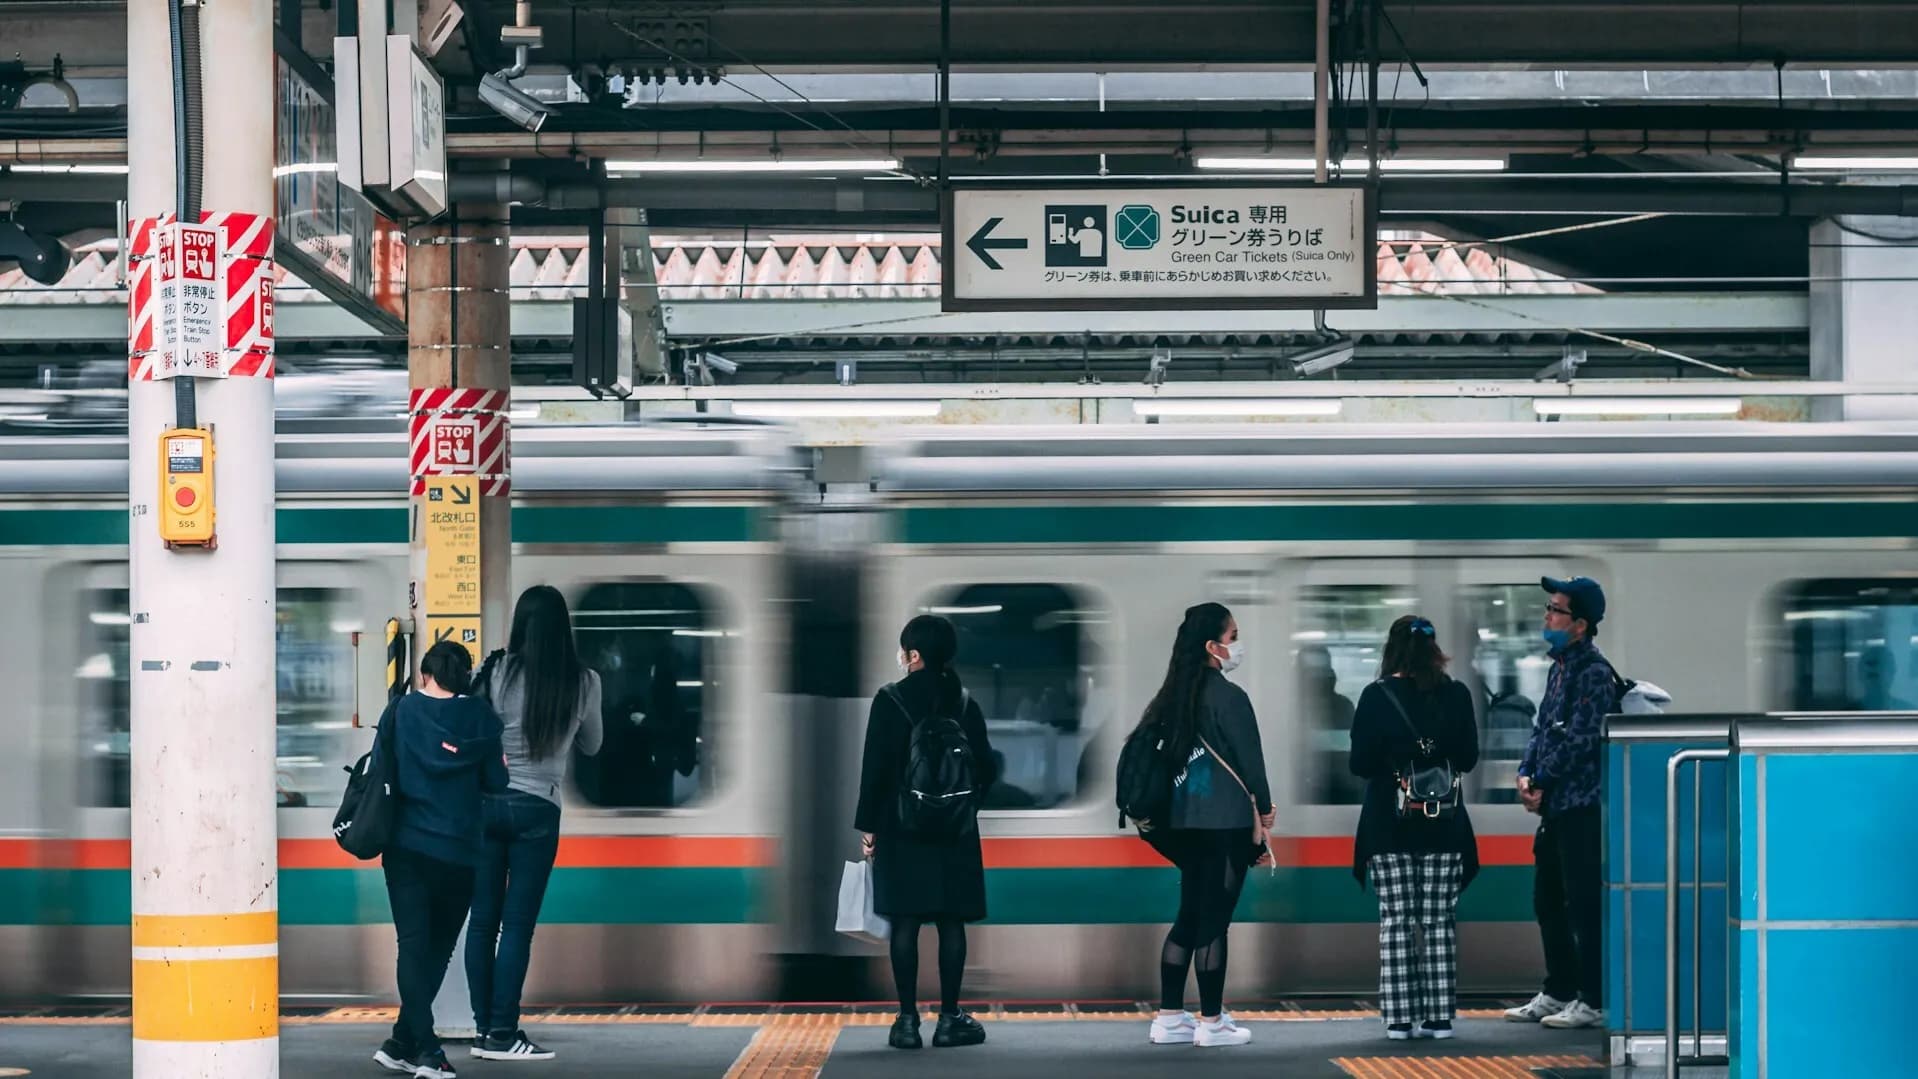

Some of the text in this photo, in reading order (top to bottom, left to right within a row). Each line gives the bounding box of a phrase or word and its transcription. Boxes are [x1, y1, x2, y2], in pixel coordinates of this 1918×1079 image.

[1171, 205, 1287, 224] Suica 専用
[183, 232, 214, 247] STOP
[1172, 229, 1324, 247] グリーン券うりば
[1171, 250, 1355, 263] Green Car Tickets (Suica Only)
[1045, 270, 1332, 283] グリーン券は、乗車前にあらかじめお買い求めください。
[183, 285, 216, 300] 非常停止
[183, 301, 208, 315] ボタン
[183, 316, 211, 325] Emergency
[183, 326, 197, 334] Train
[183, 335, 201, 343] Button
[437, 427, 472, 438] STOP
[431, 512, 476, 523] 北改札口
[457, 582, 476, 592] 西口
